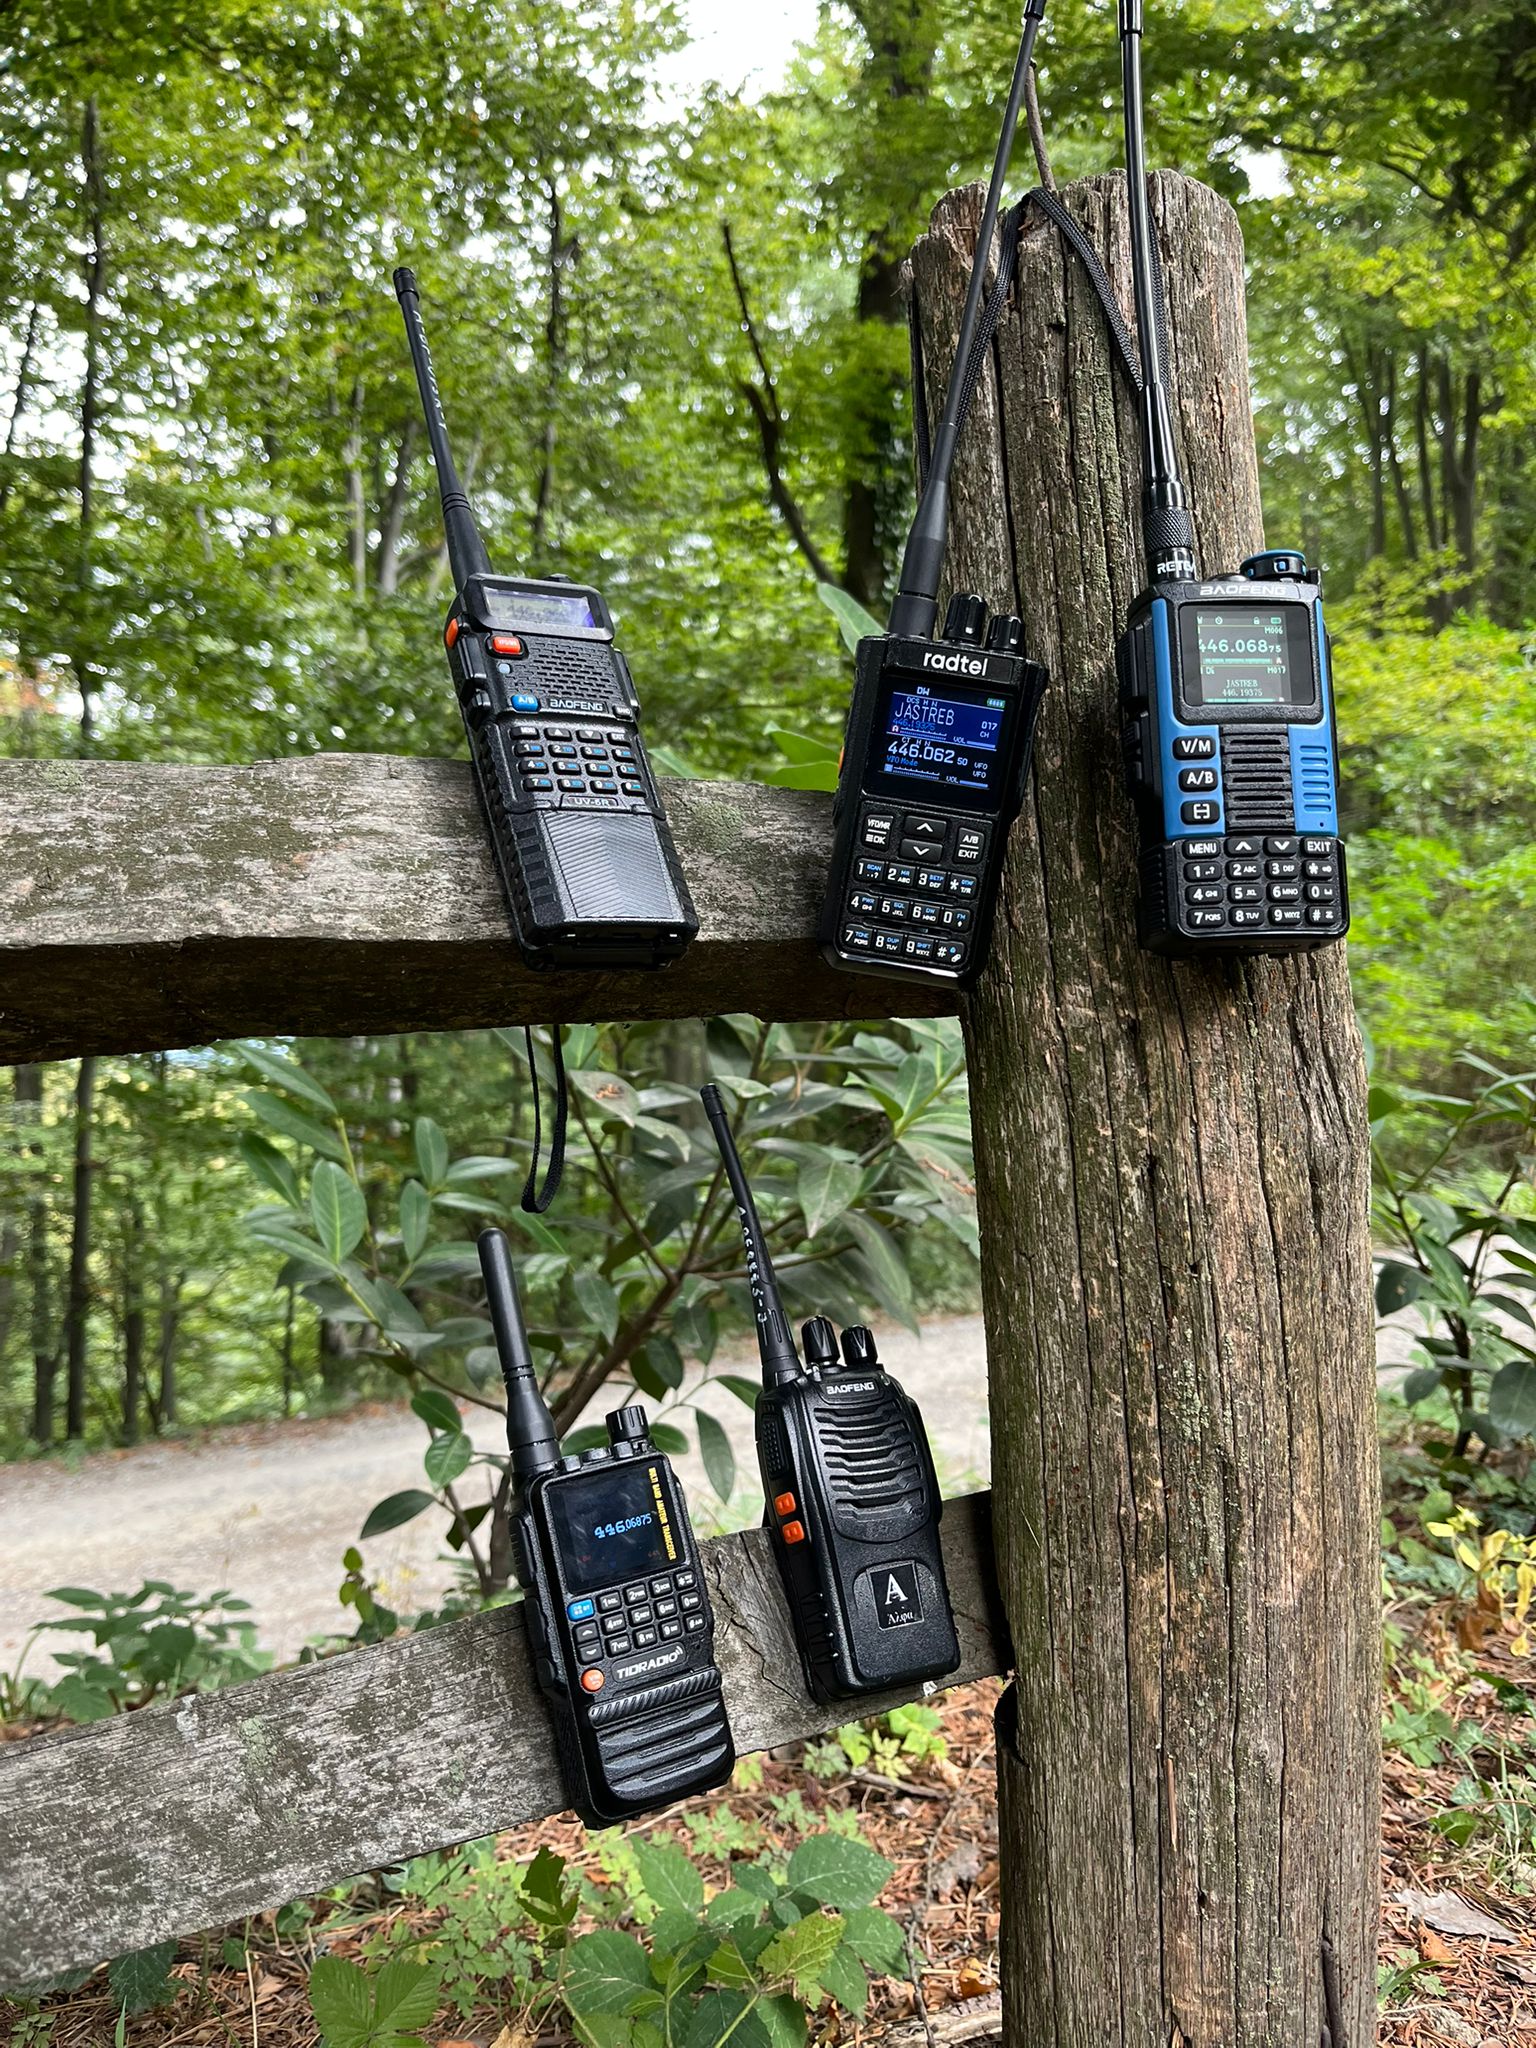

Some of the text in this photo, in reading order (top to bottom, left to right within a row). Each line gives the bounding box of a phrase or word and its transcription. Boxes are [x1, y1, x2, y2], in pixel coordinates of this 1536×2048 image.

[1200, 585, 1287, 596] BAOFENG
[1265, 627, 1283, 635] M006
[1269, 645, 1281, 653] 75
[923, 652, 988, 676] radtel
[1268, 666, 1286, 674] M017
[1226, 680, 1258, 688] JASTREB
[917, 686, 930, 696] DW
[1222, 688, 1263, 697] 446.19375
[550, 699, 603, 712] BAOFENG
[894, 701, 955, 726] JASTREB
[981, 720, 998, 731] 017
[888, 740, 955, 764] 446.062
[1182, 739, 1211, 754] V/M
[1187, 771, 1214, 785] A/B
[868, 819, 891, 830] VFO/MR
[962, 835, 979, 844] A/B
[1189, 843, 1217, 854] MENU
[1307, 841, 1331, 852] EXIT
[958, 850, 979, 859] EXIT
[859, 863, 882, 875] 1 SCAN
[888, 868, 897, 881] 2
[1194, 866, 1201, 878] 1
[1233, 864, 1242, 876] 2
[1272, 863, 1280, 875] 3
[919, 873, 928, 885] 3
[1193, 888, 1204, 900] 4
[1235, 887, 1243, 899] 5
[1273, 886, 1281, 898] 6
[1312, 886, 1320, 898] 0
[851, 896, 859, 908] 4
[882, 901, 891, 913] 5
[913, 906, 921, 918] 6
[944, 911, 953, 923] 0
[1194, 912, 1204, 924] 7
[1236, 910, 1244, 922] 8
[1274, 909, 1300, 921] 9 WXYZ
[846, 930, 854, 942] 7
[876, 936, 884, 948] 8
[906, 941, 915, 953] 9
[827, 1382, 875, 1394] BAOFENG
[655, 1584, 661, 1593] 3
[885, 1573, 909, 1605] A
[629, 1591, 636, 1601] 2
[660, 1605, 666, 1614] 6
[634, 1612, 641, 1622] 5
[607, 1620, 614, 1629] 4
[664, 1626, 671, 1635] 9
[639, 1634, 646, 1643] 8
[611, 1642, 618, 1652] 7
